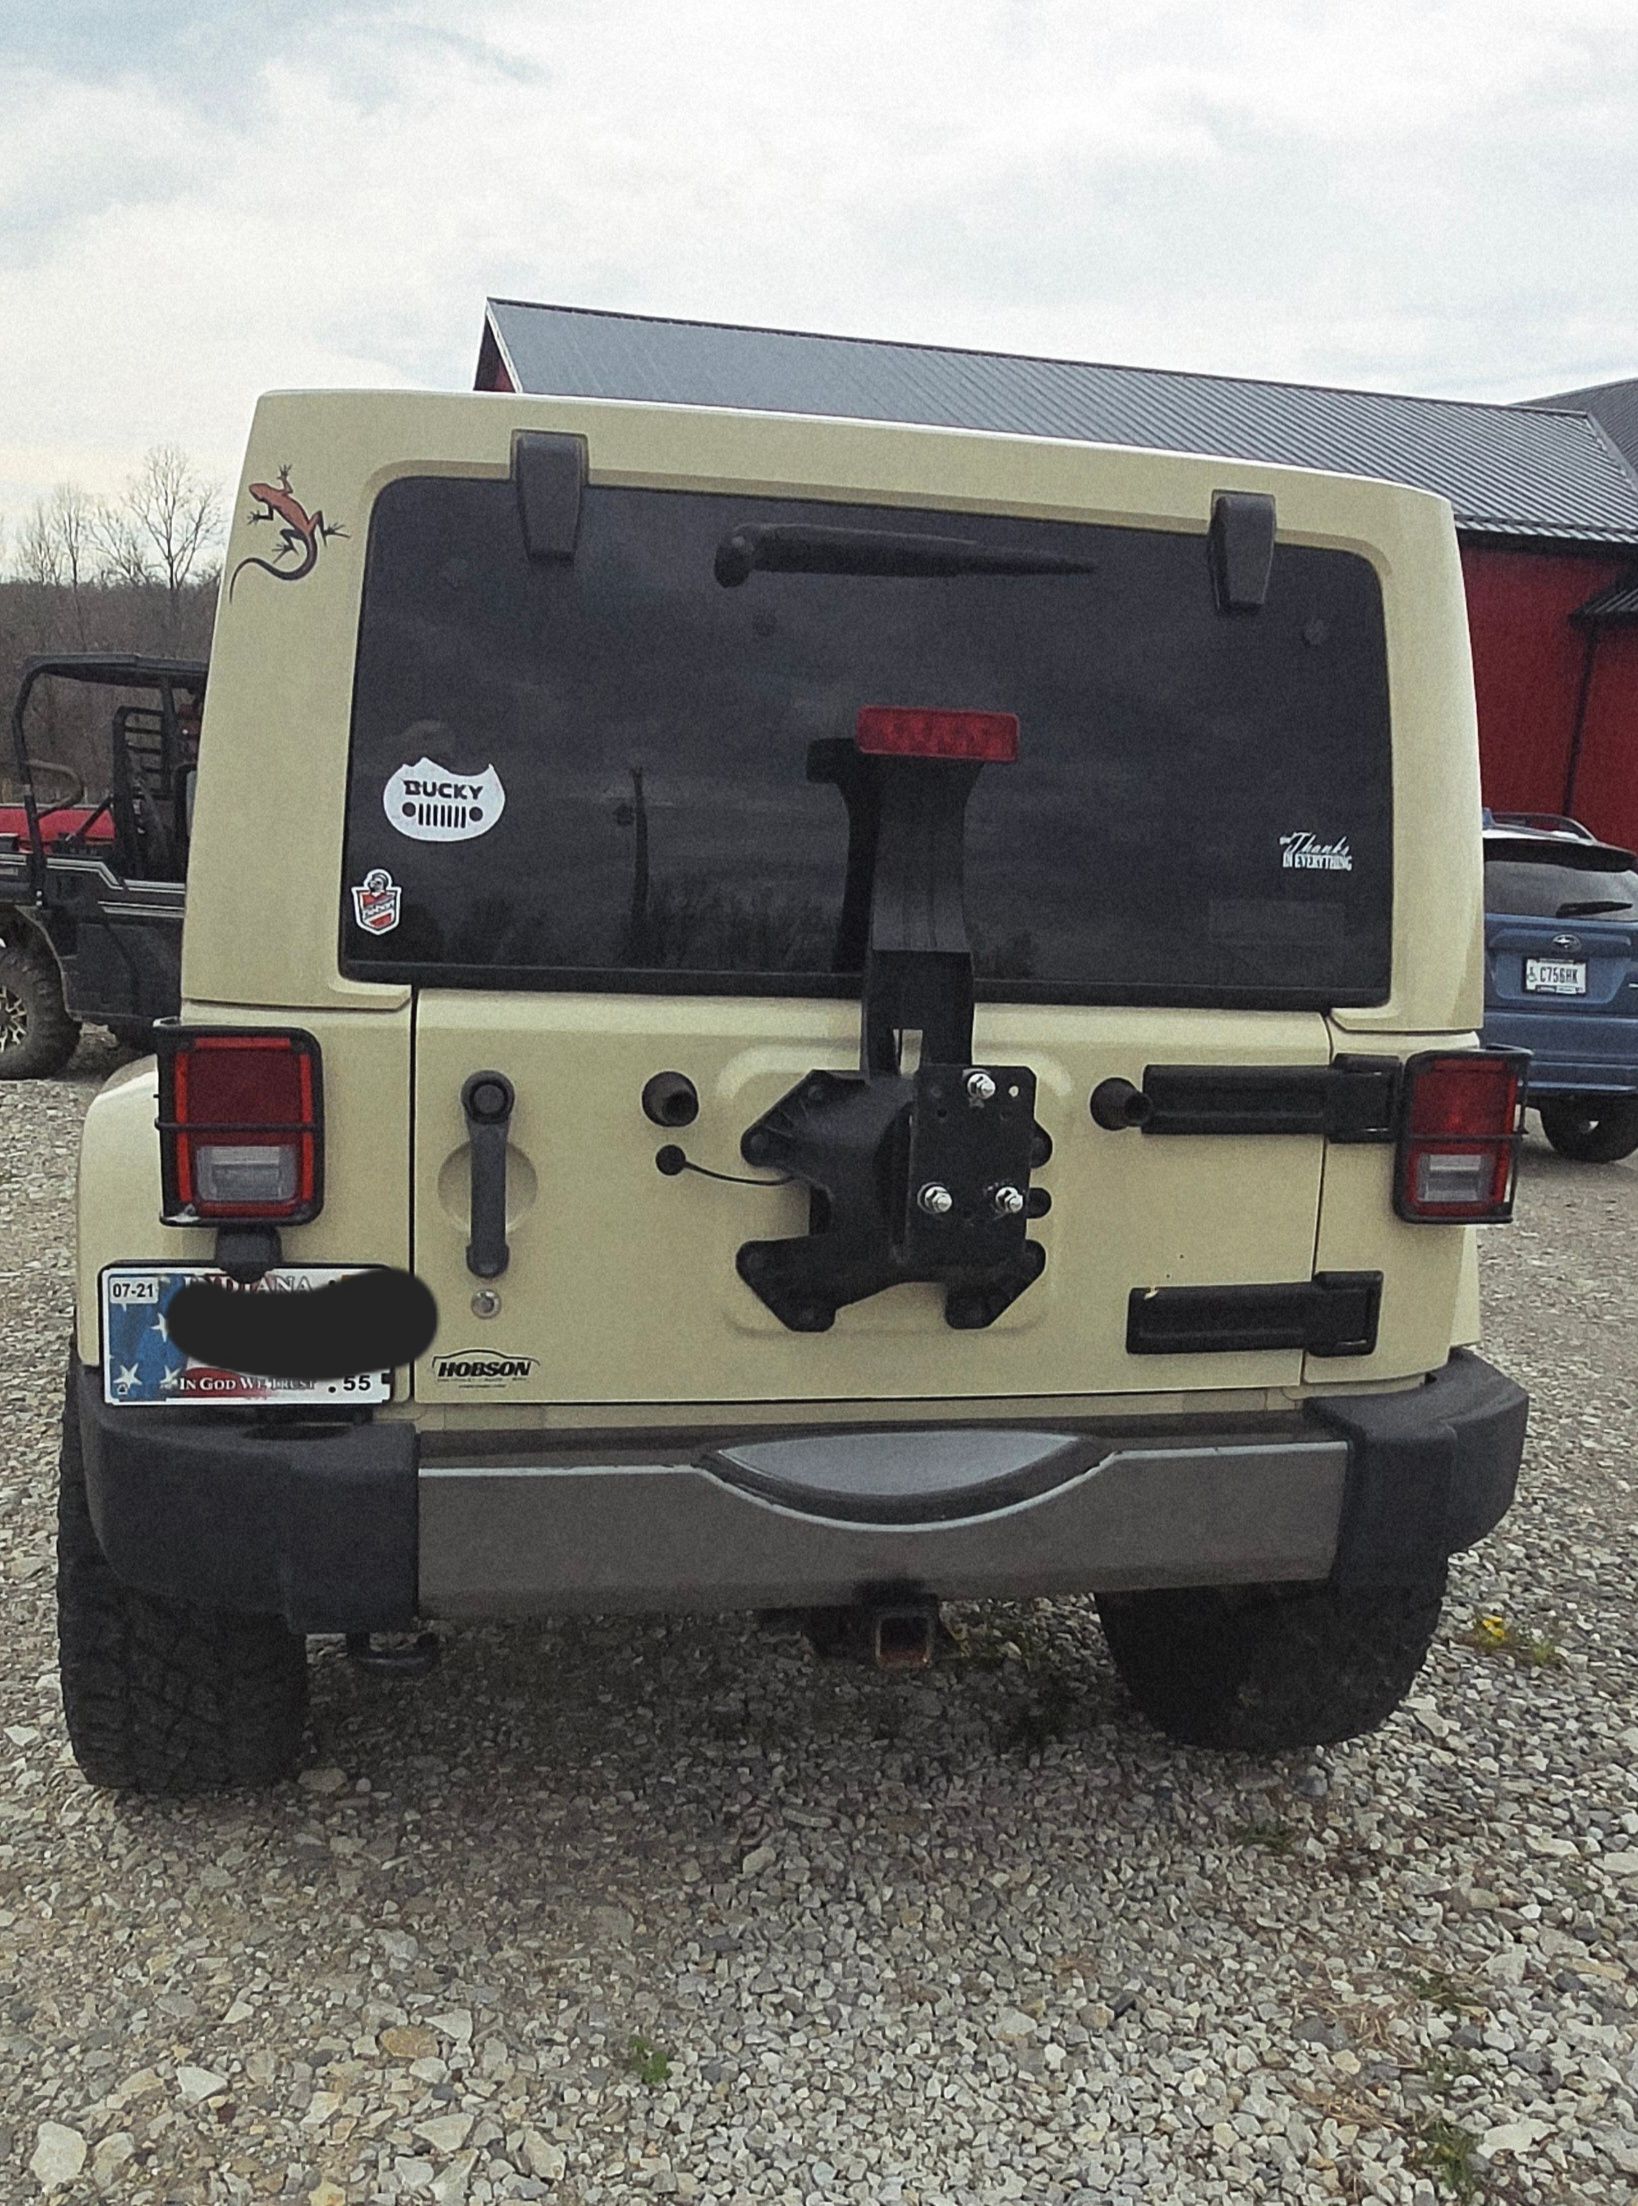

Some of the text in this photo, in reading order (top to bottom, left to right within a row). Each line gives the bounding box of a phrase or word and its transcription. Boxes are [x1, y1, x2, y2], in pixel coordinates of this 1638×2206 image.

[403, 780, 484, 800] BUCKY
[1288, 831, 1350, 856] Thanks
[112, 1282, 154, 1298] 07-21
[438, 1361, 532, 1377] HOBSON
[343, 1375, 371, 1391] 55
